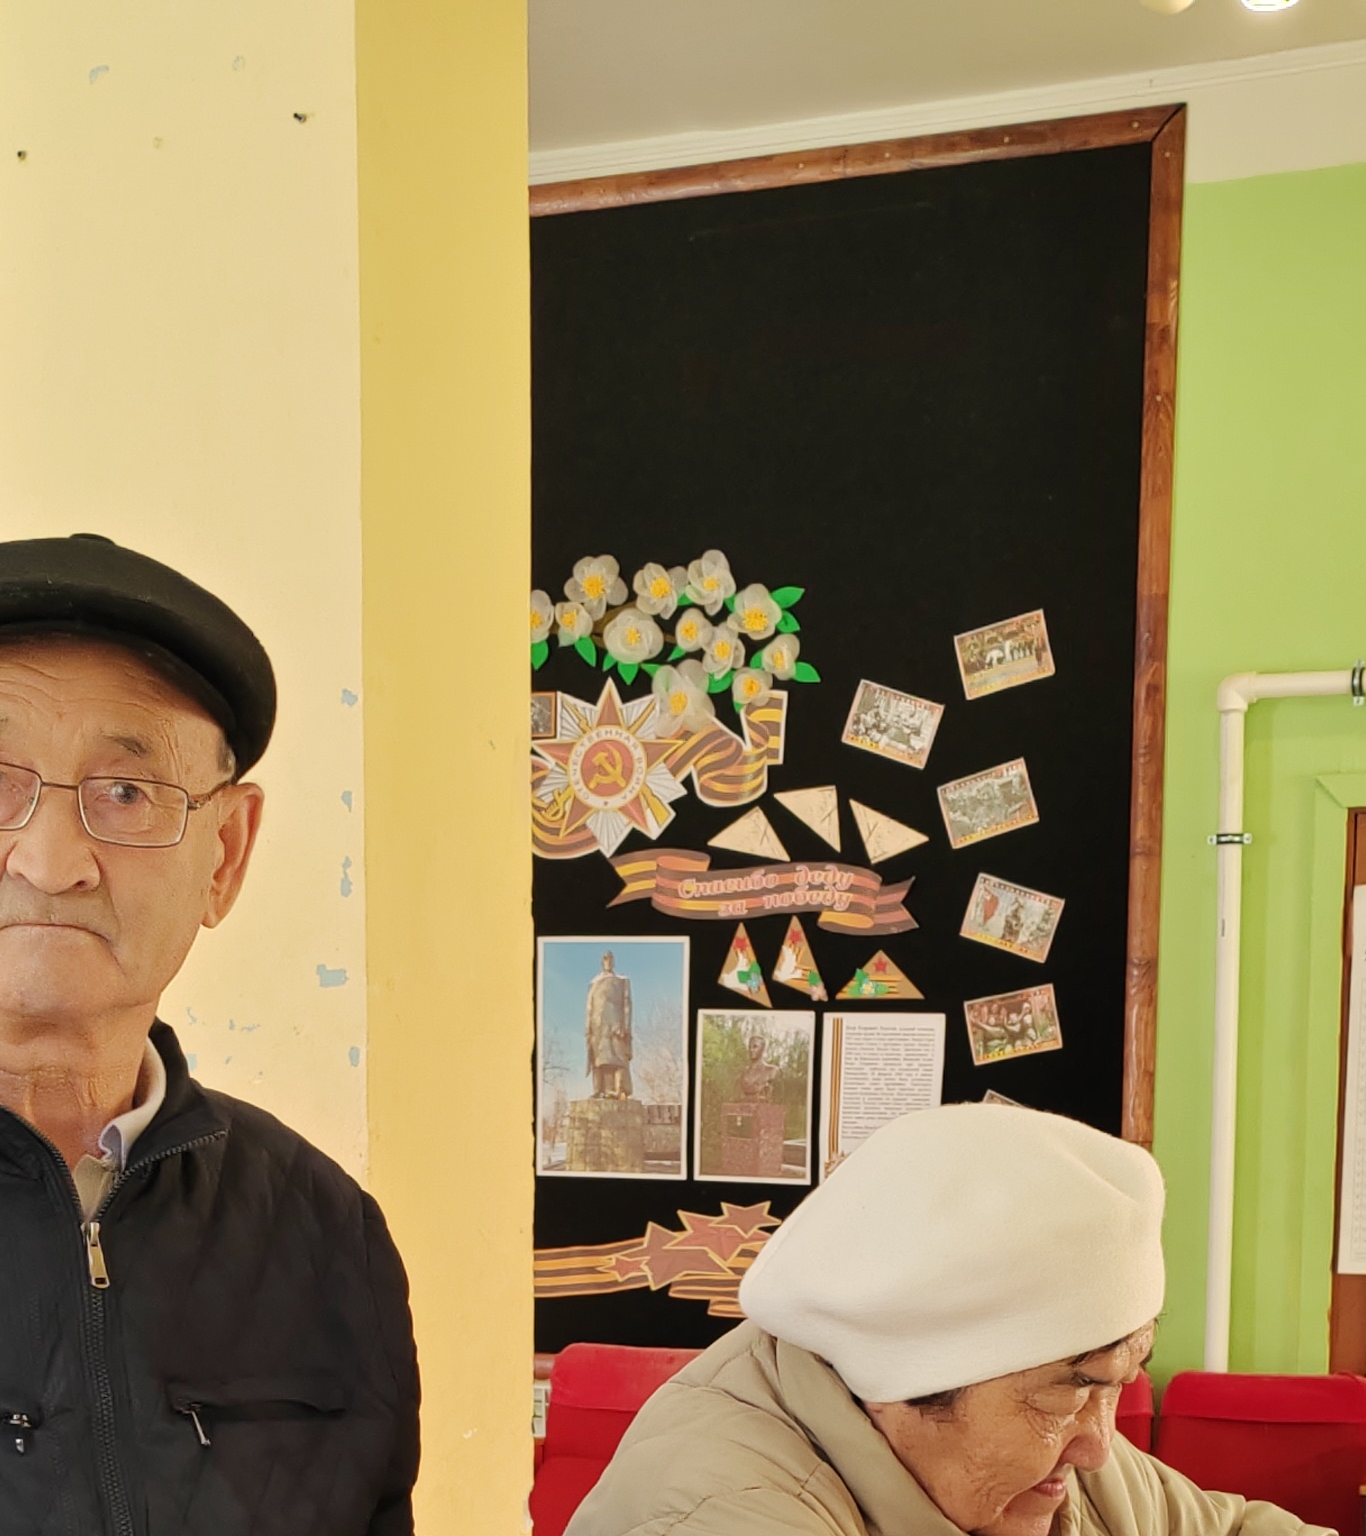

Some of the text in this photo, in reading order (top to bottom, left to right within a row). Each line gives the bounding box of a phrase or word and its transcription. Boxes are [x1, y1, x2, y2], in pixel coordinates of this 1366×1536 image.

[678, 865, 854, 899] Спасибо деду
[718, 885, 854, 917] за победу
